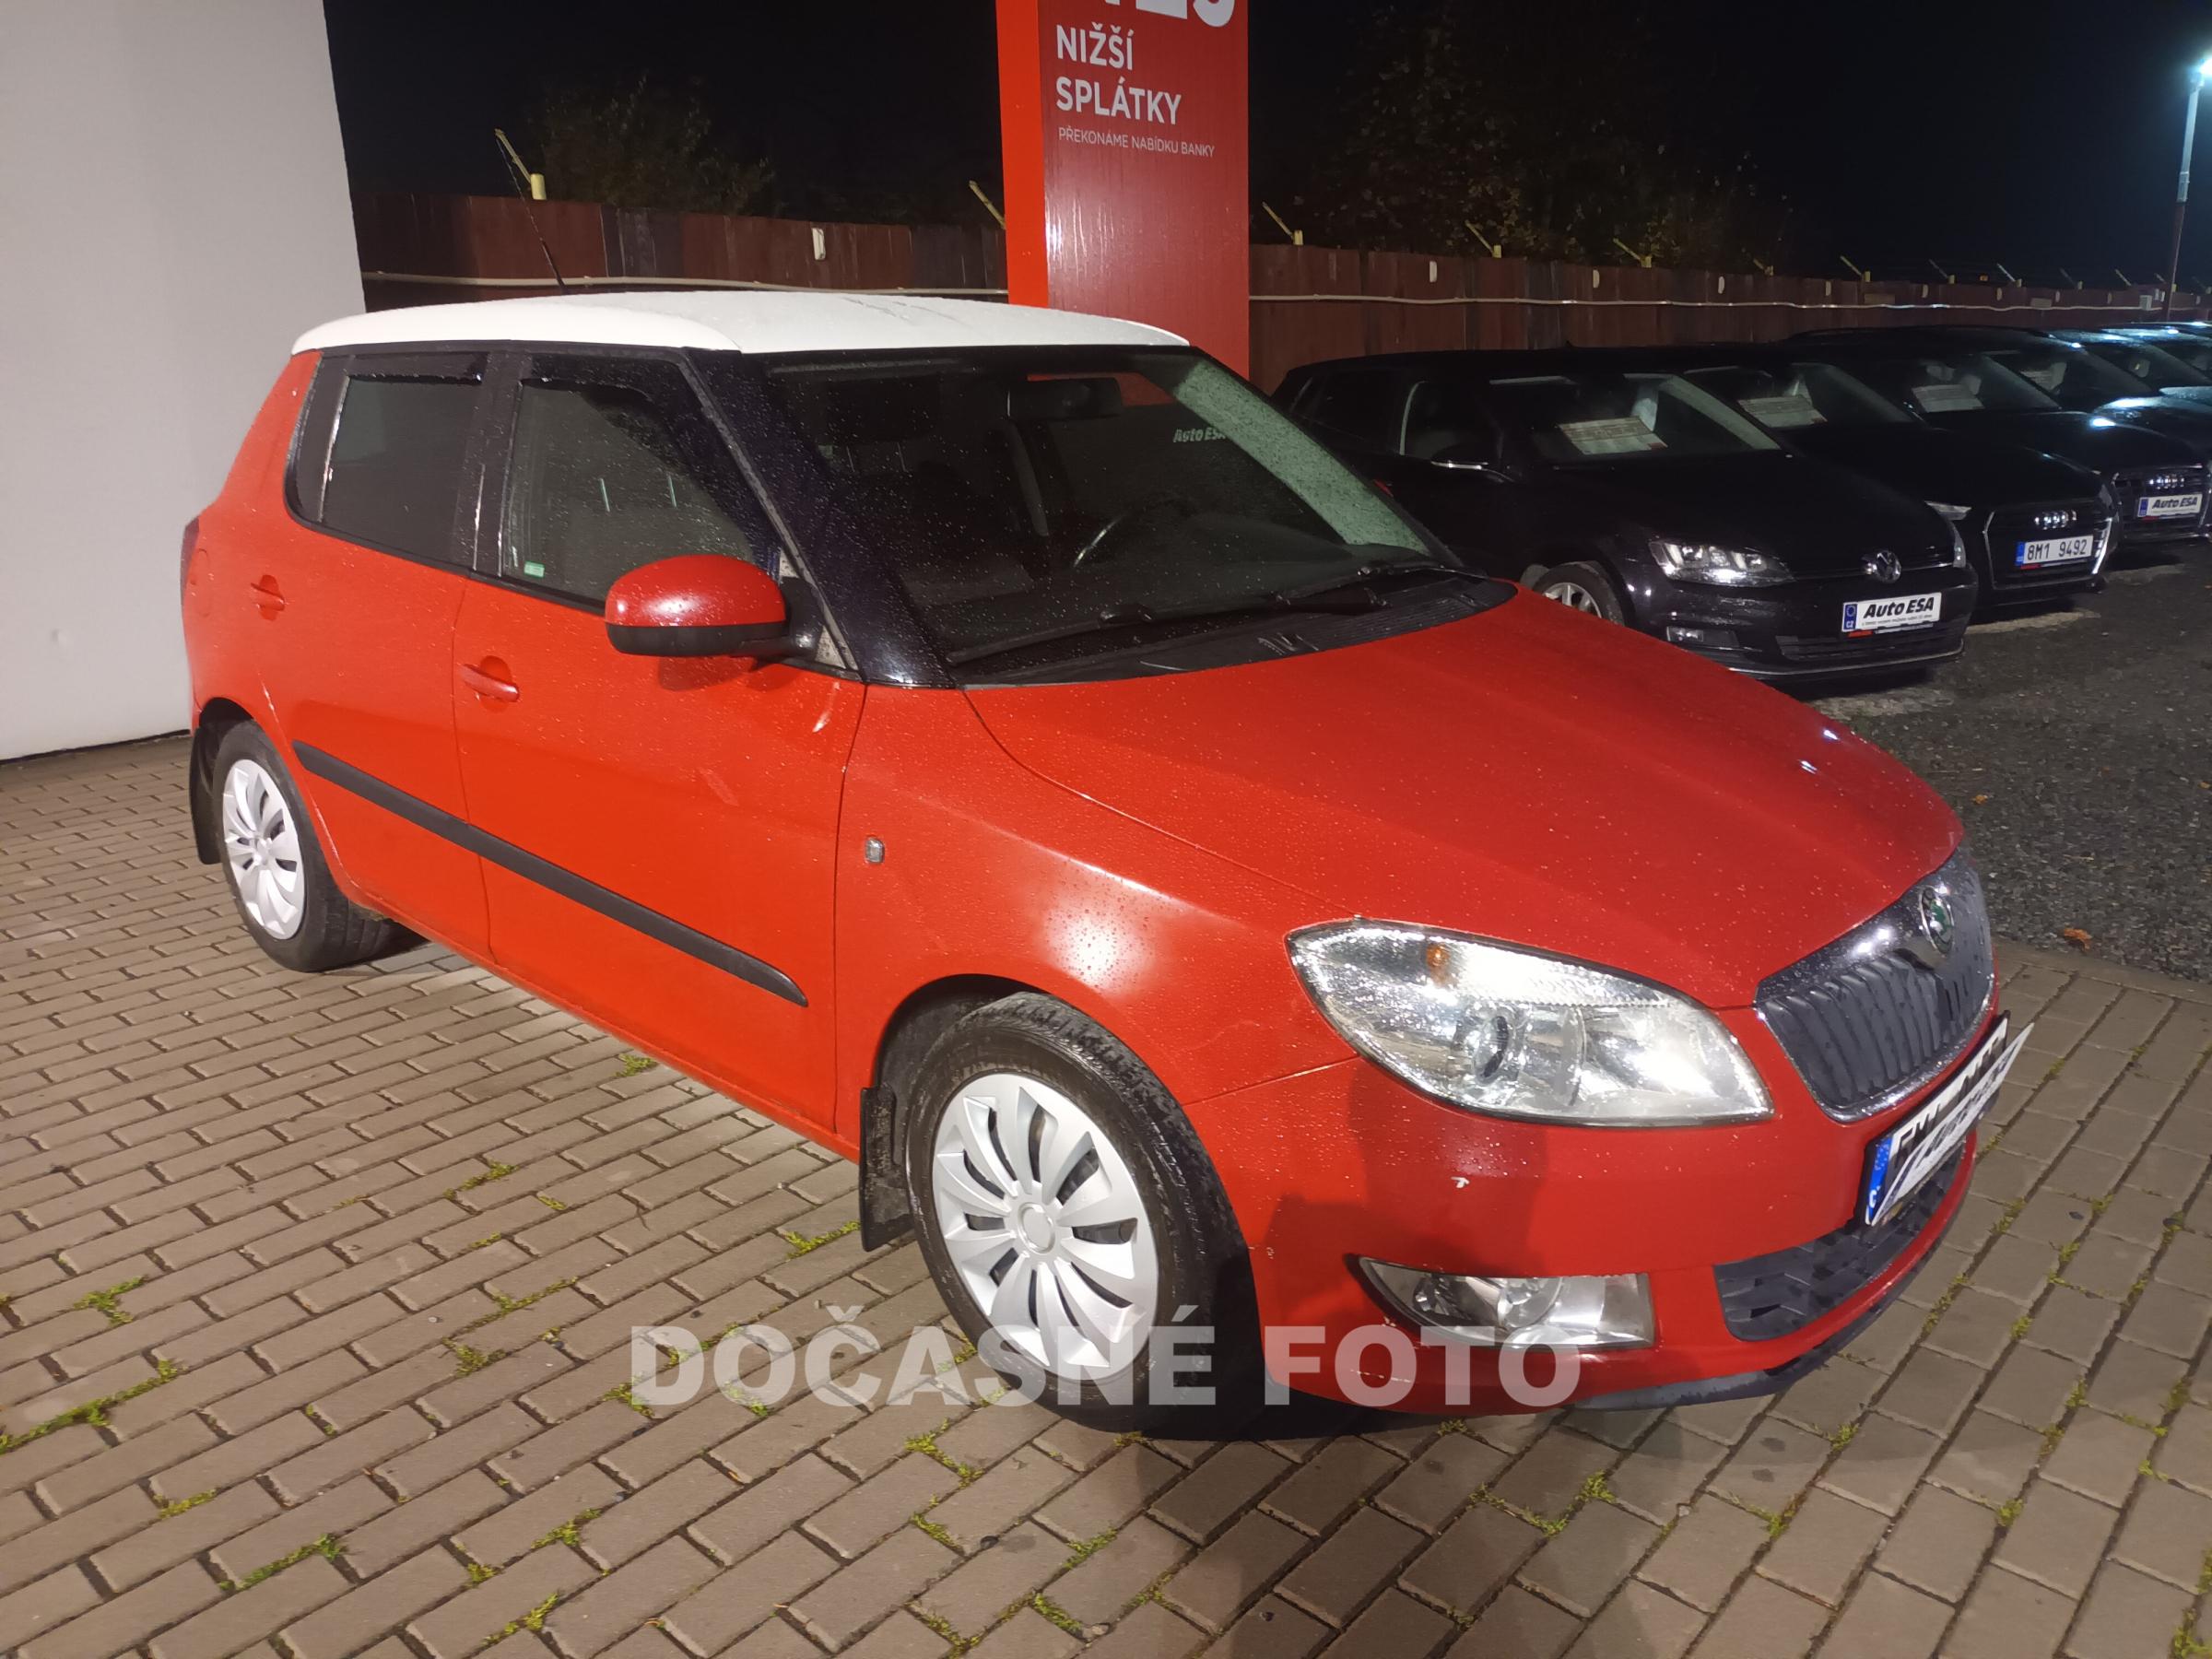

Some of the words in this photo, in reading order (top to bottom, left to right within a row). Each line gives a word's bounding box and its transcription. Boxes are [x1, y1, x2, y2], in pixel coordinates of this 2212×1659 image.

[1056, 21, 1134, 70] NIŽŠÍ
[1055, 76, 1182, 124] SPLÁTKY
[1059, 126, 1129, 147] PŘEKONÁME
[1132, 135, 1179, 154] NABÍDKU
[1181, 141, 1215, 158] BANKY
[2152, 499, 2180, 509] Auto
[2028, 543, 2050, 560] 8M1
[2059, 539, 2087, 557] 9492
[1863, 602, 1905, 618] Auto
[1905, 597, 1935, 614] ESA
